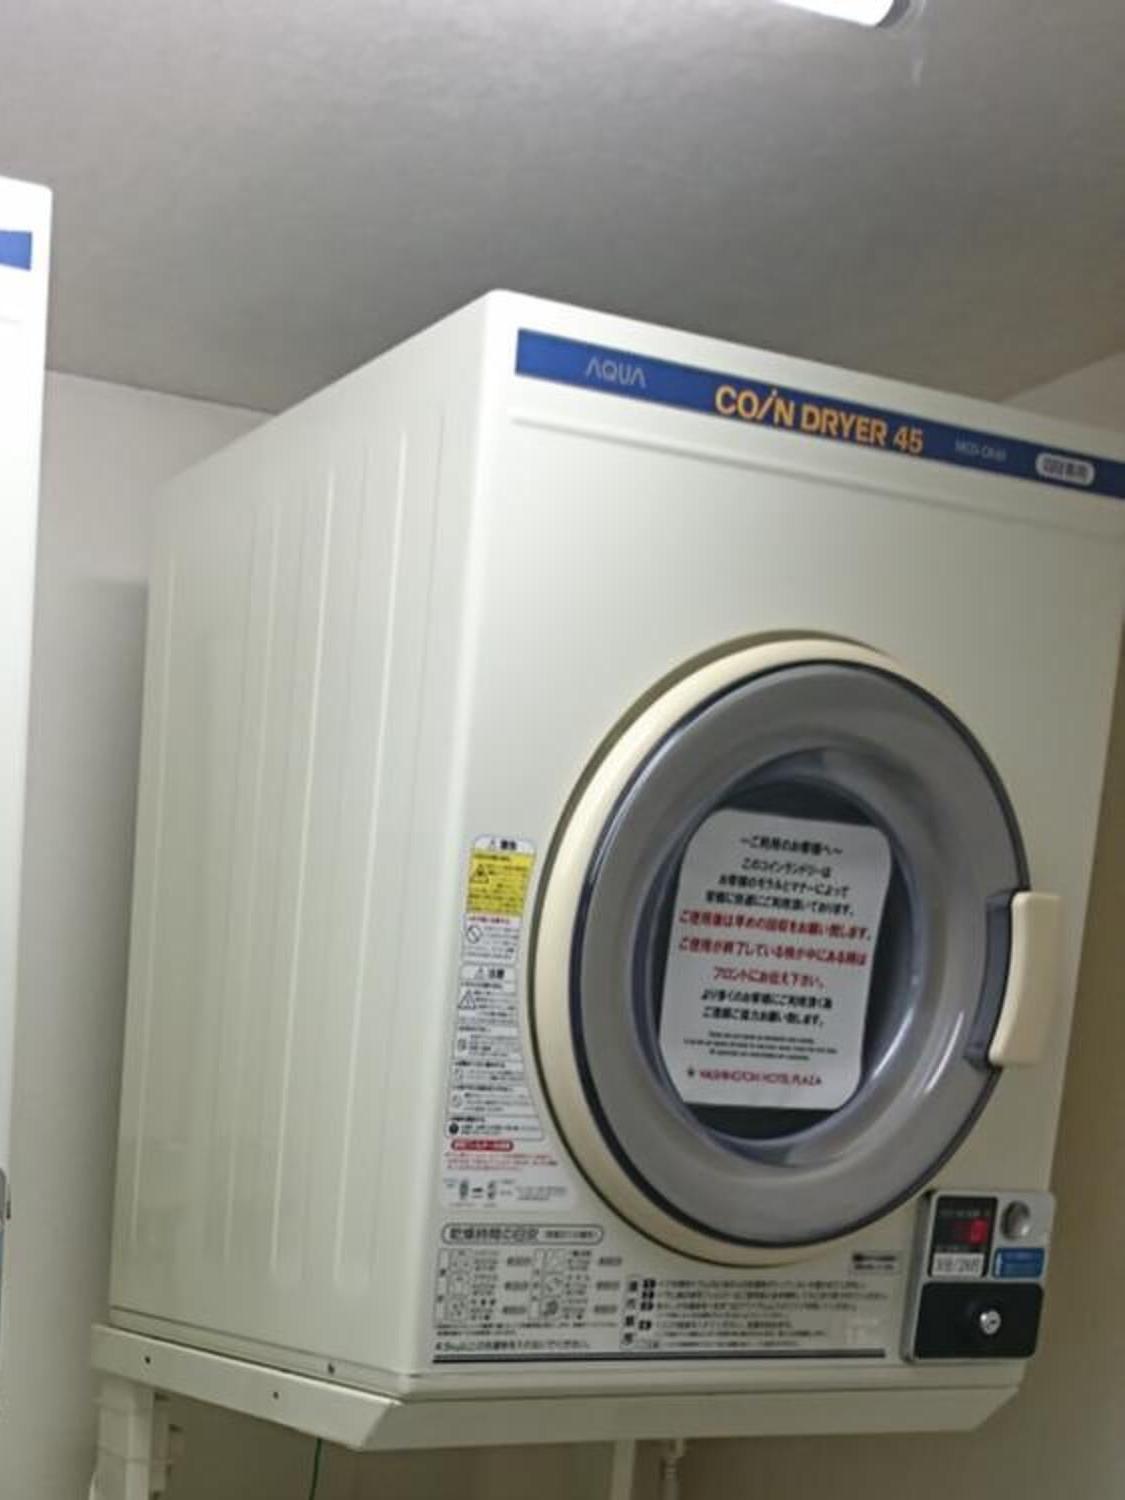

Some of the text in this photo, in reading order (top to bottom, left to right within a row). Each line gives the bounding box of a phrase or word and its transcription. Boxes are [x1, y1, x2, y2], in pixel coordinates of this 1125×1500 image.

[585, 357, 647, 388] AQUA
[801, 405, 888, 446] DRYER
[893, 424, 923, 454] 45
